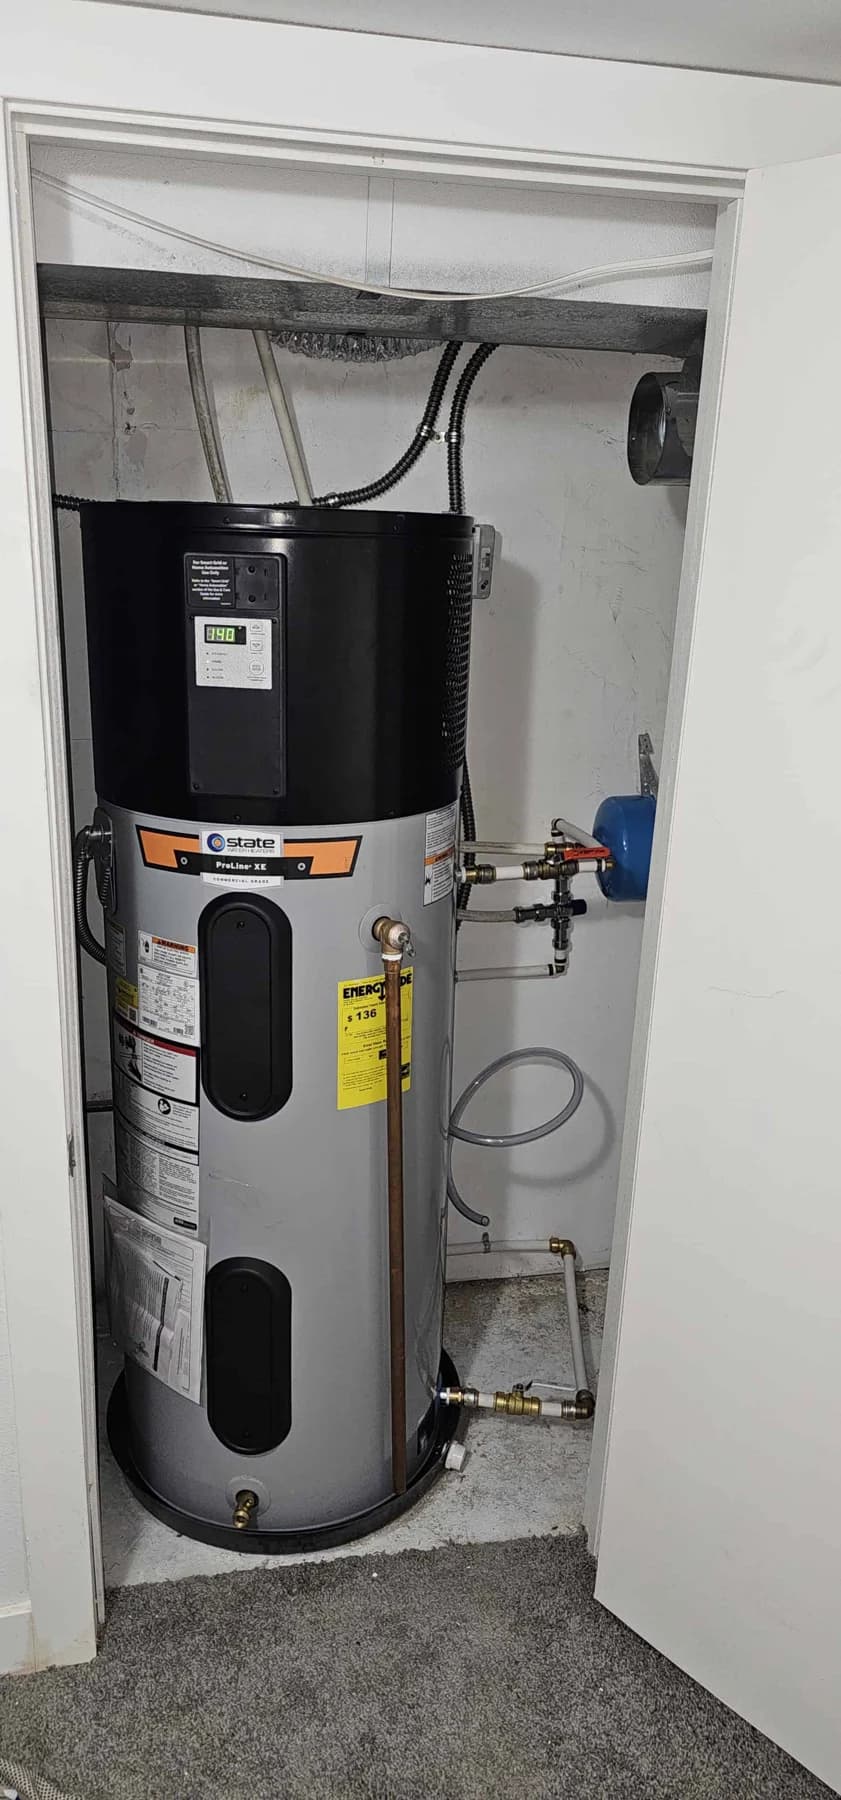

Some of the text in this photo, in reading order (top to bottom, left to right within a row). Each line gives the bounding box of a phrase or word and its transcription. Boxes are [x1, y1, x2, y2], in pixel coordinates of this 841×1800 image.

[212, 628, 235, 641] 140
[227, 837, 275, 848] state
[254, 863, 267, 871] XE
[356, 1008, 377, 1021] 136
